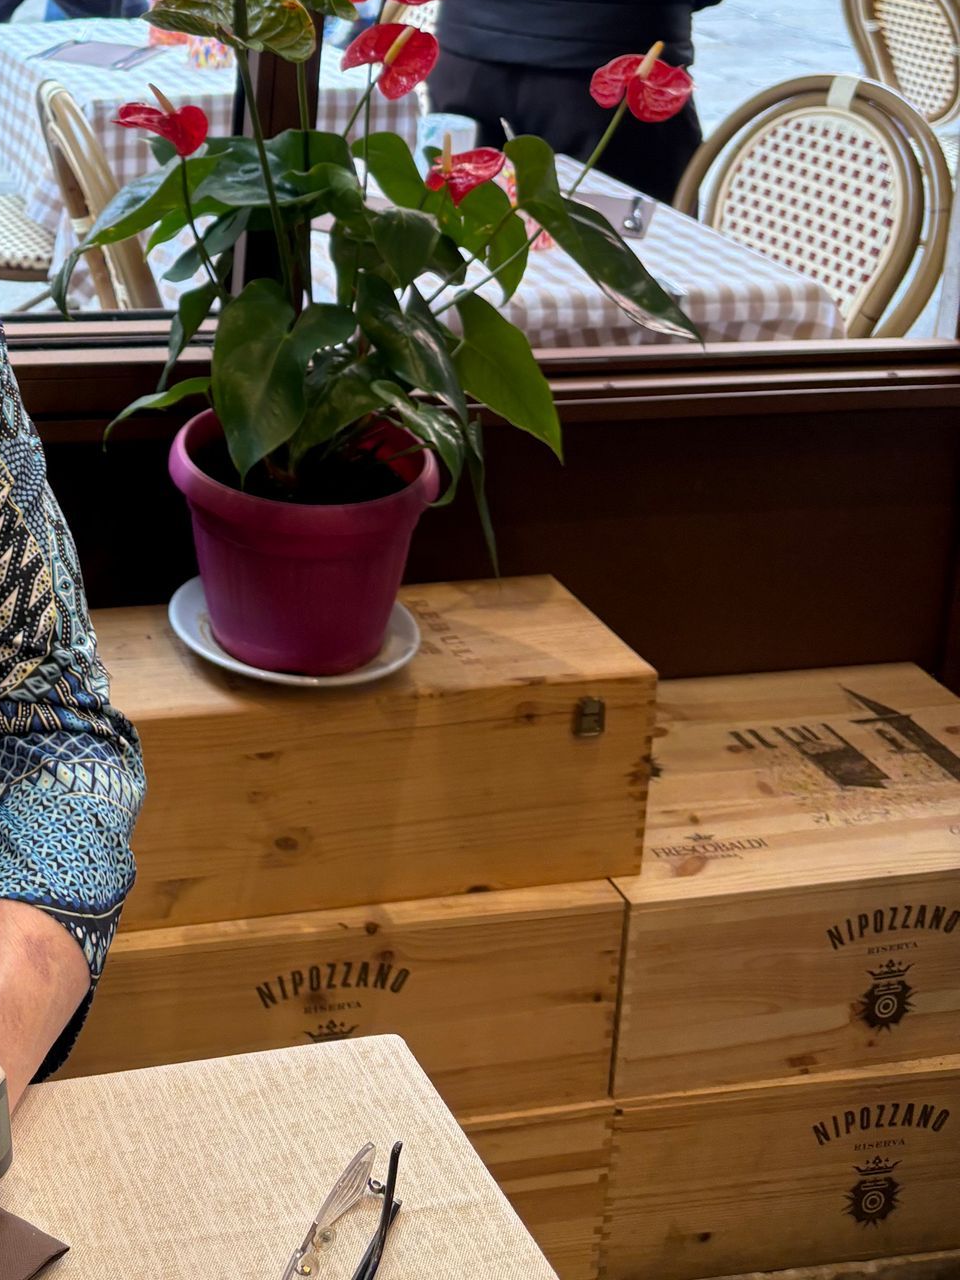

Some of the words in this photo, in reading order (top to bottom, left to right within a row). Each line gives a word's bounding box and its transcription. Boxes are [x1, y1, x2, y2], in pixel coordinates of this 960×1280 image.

[651, 837, 769, 858] FRESCOBALDI
[825, 904, 960, 951] NIPOZZANO
[867, 941, 919, 955] RISERVA
[255, 961, 411, 1010] NIPOZZANO
[303, 1000, 363, 1015] RISERVA
[812, 1103, 951, 1146] NIPOZZANO
[854, 1138, 906, 1152] RISERVA
